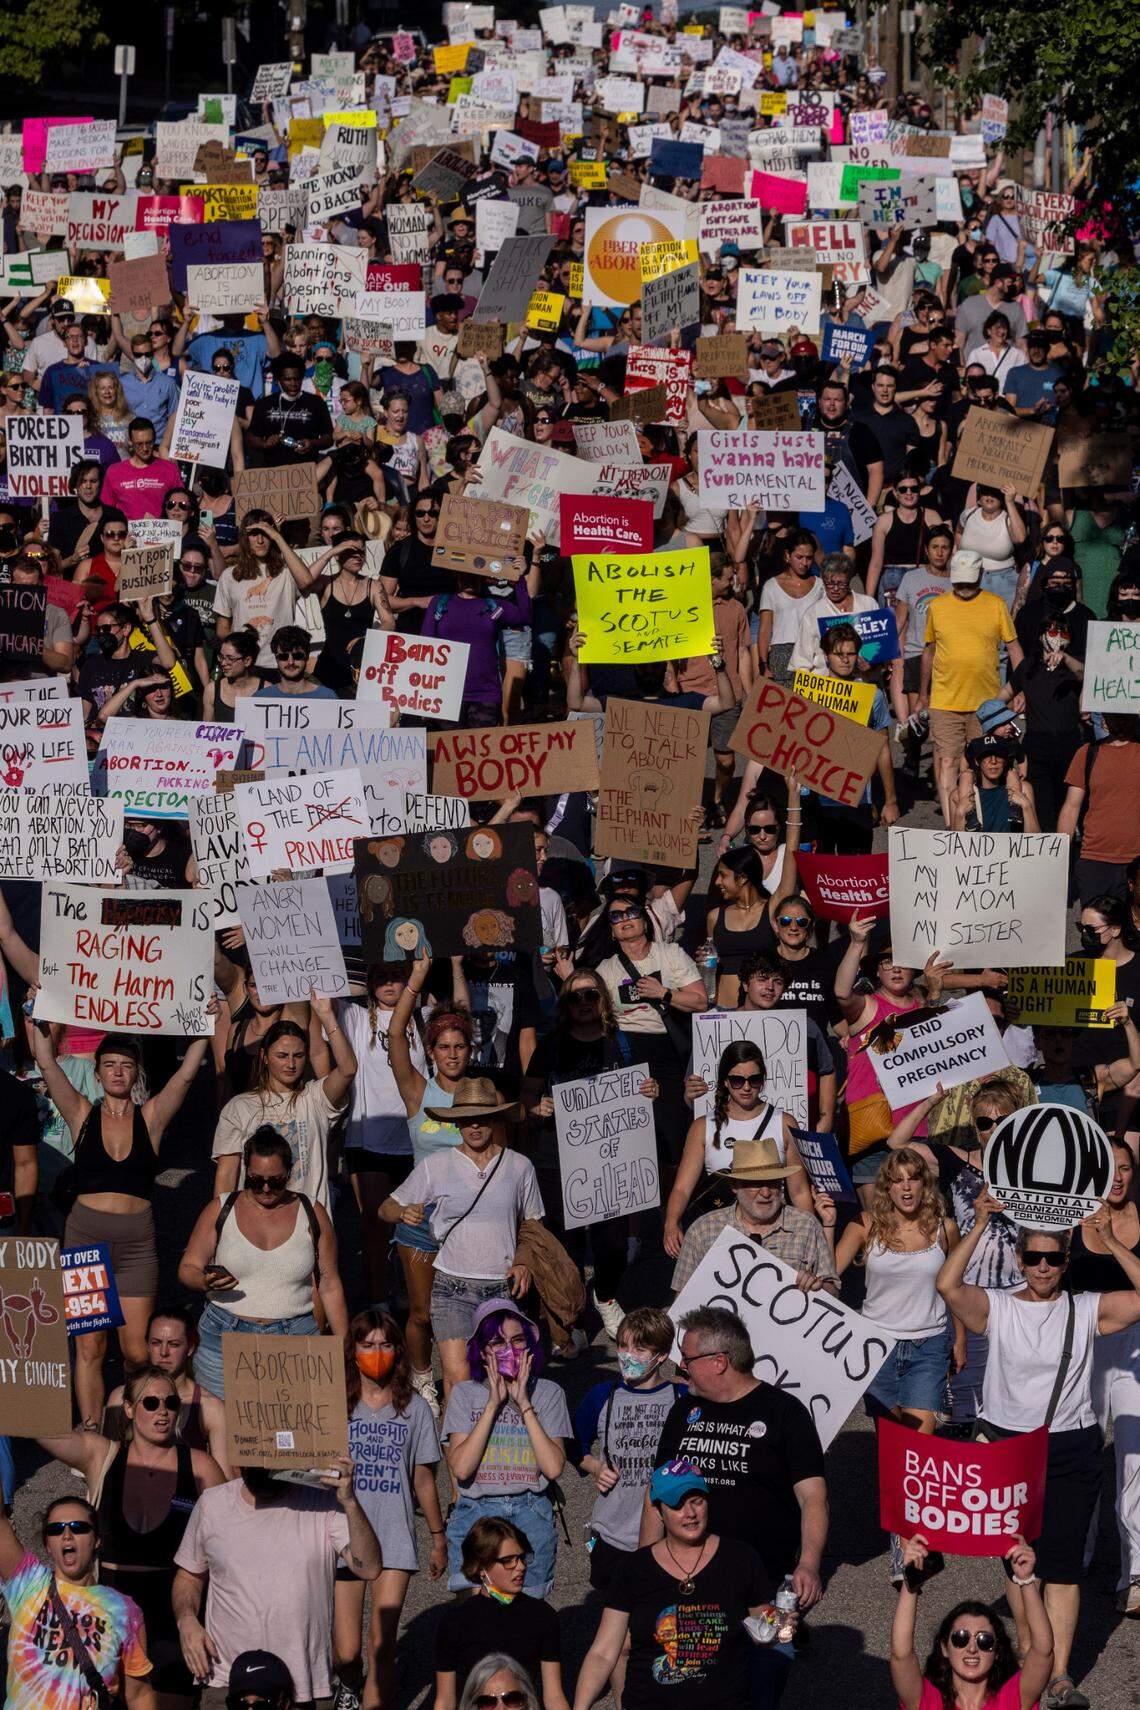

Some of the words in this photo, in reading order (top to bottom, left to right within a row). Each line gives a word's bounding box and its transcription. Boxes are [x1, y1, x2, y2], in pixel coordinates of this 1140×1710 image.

[800, 92, 821, 106] NO
[788, 104, 829, 116] FORCED
[794, 114, 829, 126] LABOR
[338, 127, 368, 145] RUTH
[849, 148, 869, 160] NO
[325, 188, 360, 210] BACK
[712, 202, 758, 211] ABORTION
[881, 195, 918, 209] WITH
[1035, 193, 1073, 210] EVERY
[93, 200, 119, 220] MY
[873, 209, 904, 222] HER
[389, 216, 425, 231] WOMAN
[702, 227, 739, 238] NEITHER
[741, 226, 759, 235] ARE
[640, 242, 681, 254] ABORTION
[792, 225, 856, 251] HELL
[287, 246, 335, 266] Banning
[642, 257, 649, 265] IS
[660, 252, 688, 262] HUMAN
[838, 252, 854, 260] NO
[195, 267, 257, 281] ABORTION
[286, 262, 351, 283] Abortions
[745, 273, 778, 286] KEEP
[216, 282, 230, 291] IS
[752, 291, 781, 300] LAWS
[788, 292, 807, 301] OFF
[197, 295, 261, 309] HEALTHCARE
[296, 298, 334, 315] Lives
[384, 298, 410, 308] BODY
[775, 307, 808, 324] BODY
[832, 329, 866, 343] MARCH
[628, 360, 655, 375] THIS
[181, 418, 197, 427] gay
[184, 409, 205, 419] black
[8, 417, 70, 440] FORCED
[179, 427, 217, 439] transgender
[602, 424, 630, 437] YOUR
[188, 438, 220, 449] immigrant
[711, 432, 759, 448] Girls
[773, 432, 815, 448] just
[10, 447, 56, 467] BIRTH
[66, 447, 83, 467] IS
[491, 441, 559, 480] WHAT
[712, 452, 775, 467] wanna
[783, 451, 823, 468] have
[236, 467, 314, 494] ABORTION
[573, 512, 618, 526] Abortion
[622, 517, 629, 526] is
[574, 525, 614, 539] Health
[616, 529, 642, 542] Care.
[125, 552, 143, 565] MY
[146, 548, 173, 562] BODY
[139, 565, 155, 575] MY
[588, 561, 694, 583] ABOLISH
[122, 572, 170, 590] BUSINESS
[616, 588, 667, 603] THE
[600, 607, 699, 632] SCOTUS
[385, 635, 451, 666] Bans
[613, 633, 688, 655] SENATE
[365, 664, 399, 683] off
[409, 671, 445, 690] our
[796, 673, 852, 696] ABORTION
[382, 686, 442, 713] Bodies
[817, 693, 858, 713] HUMAN
[37, 708, 71, 725] BODY
[255, 703, 310, 729] THIS
[338, 706, 355, 729] IS
[607, 704, 634, 731] WE
[645, 711, 700, 738] NEED
[757, 684, 835, 746] PRO
[42, 742, 75, 758] LIFE
[358, 731, 426, 767] WOMAN
[499, 732, 540, 755] OFF
[547, 729, 577, 752] MY
[608, 732, 635, 750] TO
[645, 736, 697, 760] TALK
[627, 751, 677, 770] ABOUT
[747, 722, 863, 804] CHOICE
[157, 776, 209, 789] FUCKING
[455, 752, 547, 798] BODY
[313, 779, 334, 799] OF
[605, 789, 634, 806] THE
[196, 793, 235, 815] KEEP
[405, 792, 468, 826] DEFEND
[91, 818, 115, 838] YOU
[196, 813, 240, 836] YOUR
[265, 807, 302, 830] THE
[600, 805, 671, 829] ELEPHANT
[680, 818, 693, 833] IN
[610, 826, 640, 843] THE
[647, 830, 692, 857] WOMB
[895, 830, 917, 861] I
[933, 833, 995, 858] STAND
[1009, 836, 1062, 859] WITH
[199, 863, 227, 885] OFF
[915, 865, 937, 888] MY
[956, 861, 1009, 886] WIFE
[253, 887, 303, 912] ANGRY
[914, 891, 938, 911] MY
[956, 890, 1015, 912] MOM
[48, 891, 87, 920] The
[193, 900, 209, 930] IS
[245, 911, 322, 940] WOMEN
[913, 920, 936, 945] MY
[949, 920, 1022, 945] SISTER
[76, 928, 162, 962] RAGING
[42, 959, 59, 976] but
[260, 956, 330, 977] CHANGE
[67, 962, 98, 989] The
[114, 967, 174, 1000] Harm
[190, 974, 206, 1001] IS
[284, 974, 346, 1000] WORLD
[1044, 978, 1097, 995] HUMAN
[799, 992, 825, 1002] Care.
[75, 995, 162, 1029] ENDLESS
[696, 1018, 752, 1059] WHY
[763, 1016, 800, 1059] DO
[911, 1019, 942, 1039] END
[883, 1025, 985, 1070] COMPULSORY
[897, 1046, 988, 1087] PREGNANCY
[566, 1106, 651, 1146] STATES
[600, 1138, 620, 1158] OF
[989, 1108, 1109, 1197] NOW
[996, 1190, 1095, 1209] NATIONAL
[1003, 1202, 1084, 1217] ORGANIZATION
[1014, 1212, 1030, 1220] FOR
[1033, 1214, 1073, 1224] WOMEN
[16, 1240, 59, 1270] BODY
[75, 1250, 100, 1264] OVER
[713, 1242, 888, 1382] SCOTUS
[81, 1319, 93, 1328] the
[25, 1361, 67, 1388] CHOICE
[235, 1350, 333, 1385] ABORTION
[277, 1389, 290, 1402] IS
[236, 1399, 330, 1436] HEALTHCARE
[687, 1421, 705, 1432] THIS
[706, 1423, 714, 1433] IS
[715, 1424, 744, 1435] WHAT
[366, 1435, 383, 1443] AND
[679, 1437, 750, 1457] FEMINIST
[675, 1455, 716, 1469] LOOKS
[721, 1459, 749, 1473] LIKE
[904, 1449, 983, 1488] BANS
[903, 1475, 956, 1507] OFF
[962, 1482, 1028, 1512] OUR
[904, 1498, 1020, 1536] BODIES
